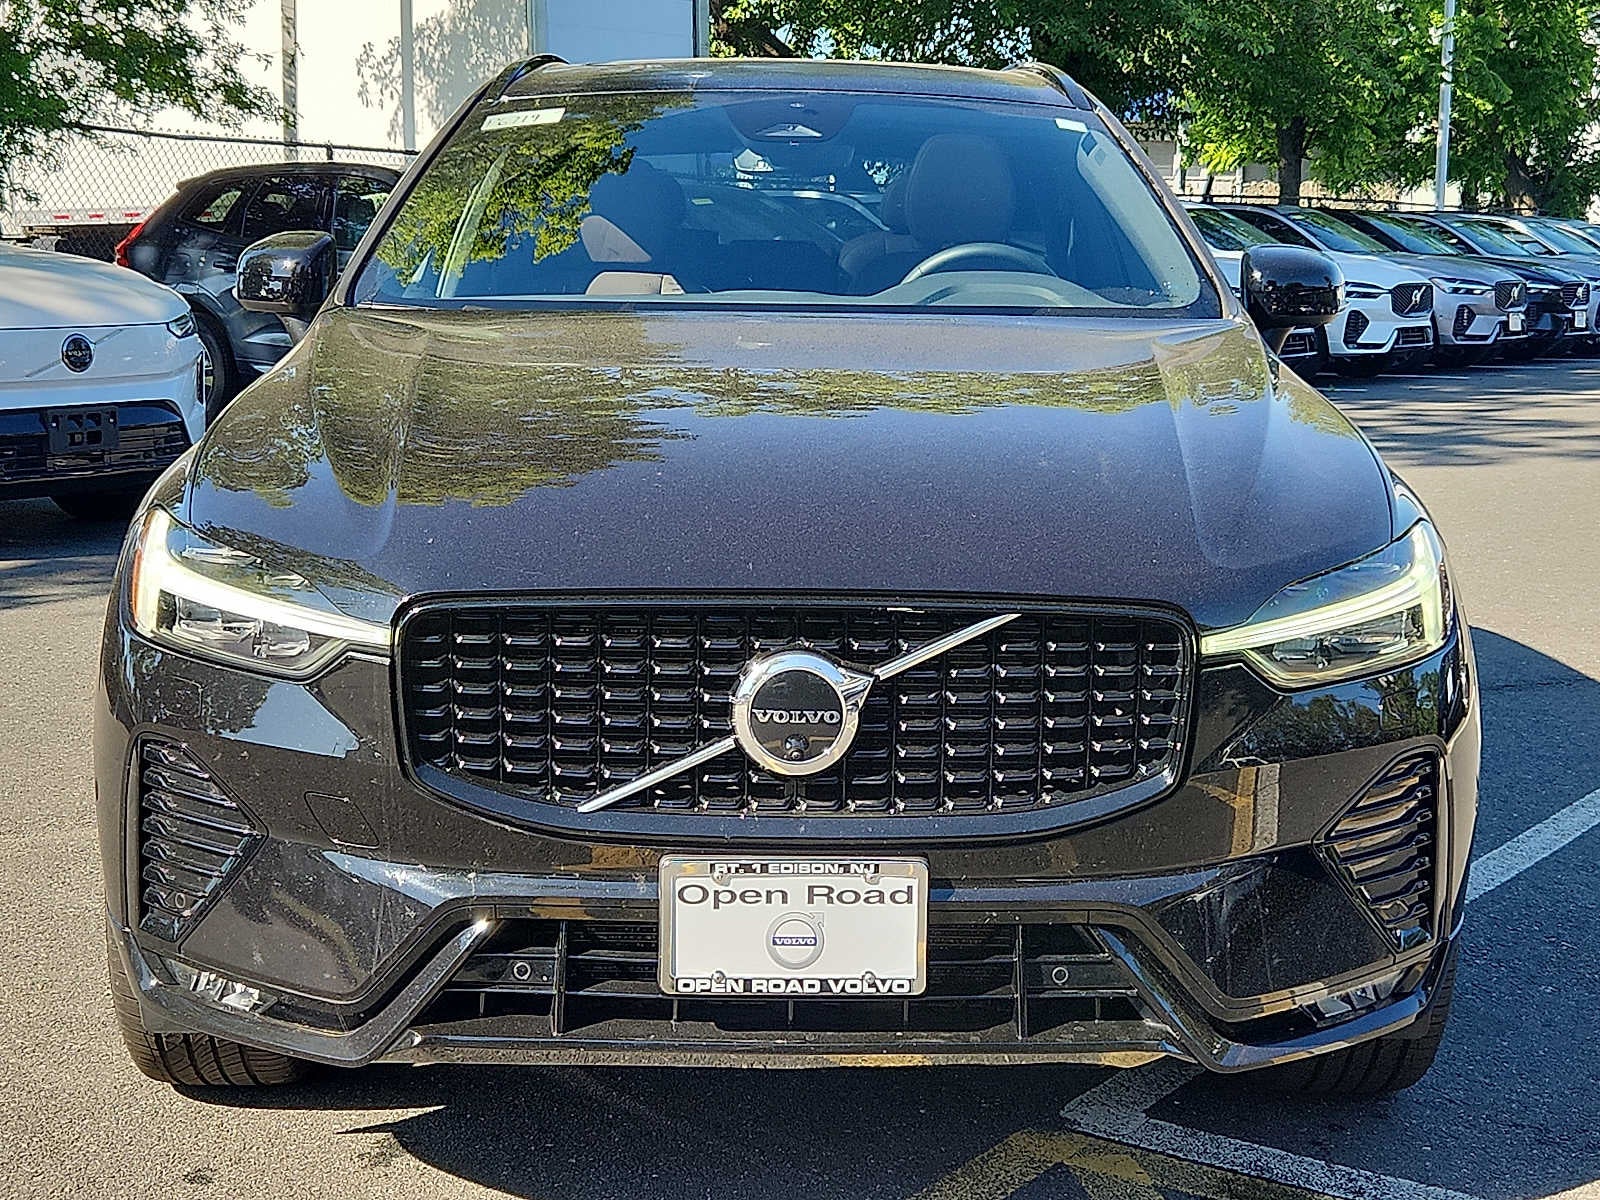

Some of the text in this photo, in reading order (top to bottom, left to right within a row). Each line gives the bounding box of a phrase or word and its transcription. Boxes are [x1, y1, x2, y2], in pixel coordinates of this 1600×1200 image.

[752, 709, 841, 724] VOLVO
[714, 863, 745, 874] RT.
[752, 863, 762, 874] 1
[851, 863, 876, 874] NJ
[677, 884, 913, 909] Open Road
[774, 937, 816, 946] VOLVO
[677, 978, 911, 993] OPEN ROAD VOLVO
